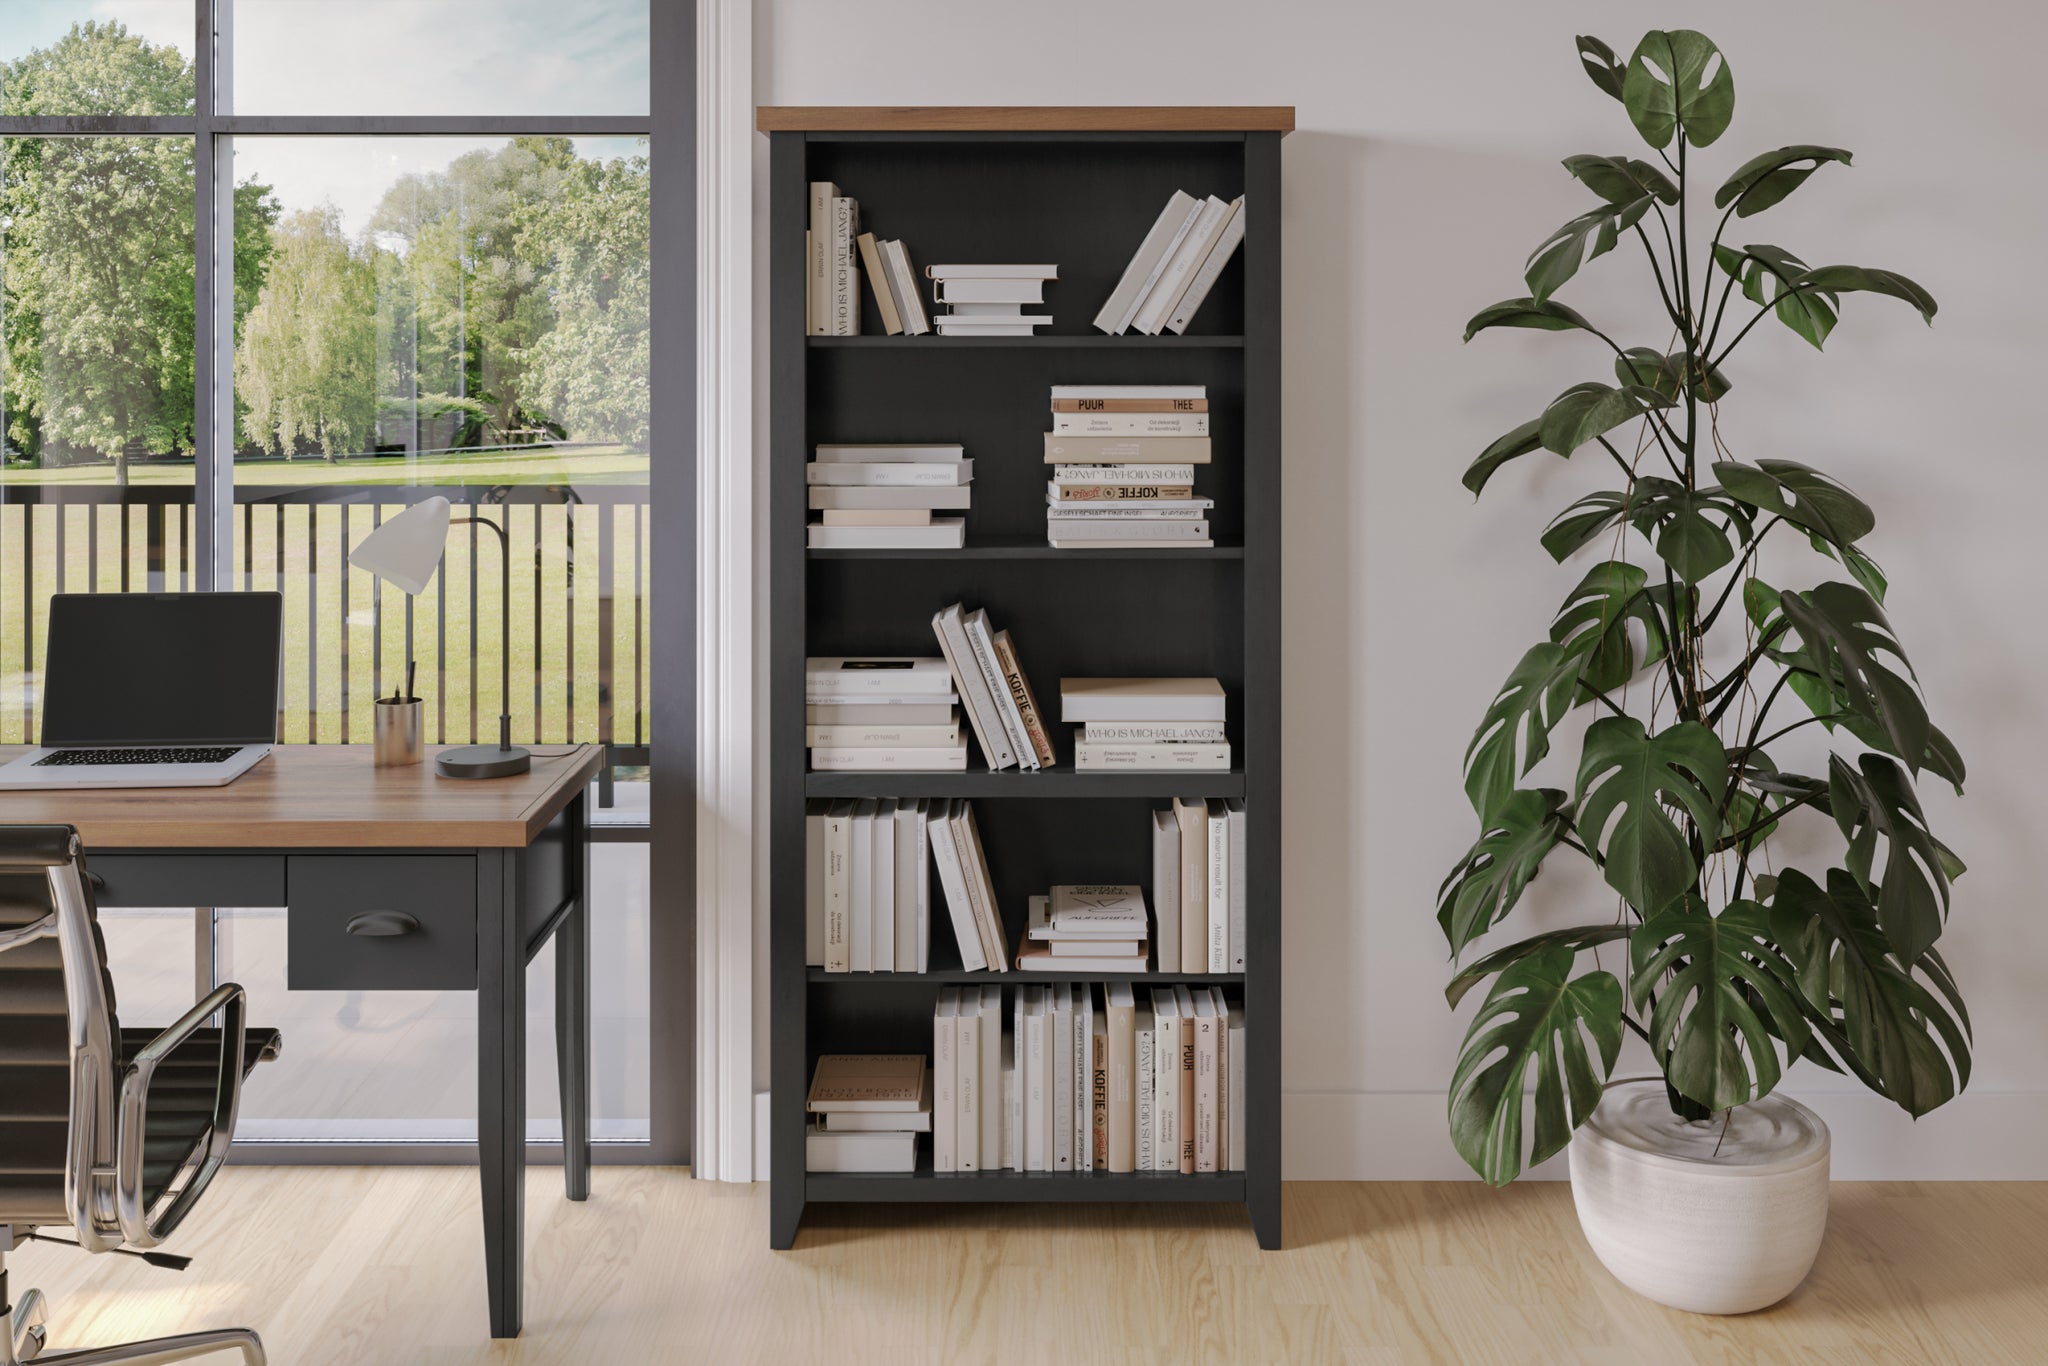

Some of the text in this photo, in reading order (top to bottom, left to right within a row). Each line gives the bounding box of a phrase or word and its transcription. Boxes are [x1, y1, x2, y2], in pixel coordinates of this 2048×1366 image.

[838, 206, 848, 336] WHO IS MICHAEL JANG?
[1078, 400, 1193, 410] PUUR THEE
[1065, 470, 1193, 479] WHO IS MICHAEL JANG?
[1118, 487, 1158, 498] KOFFIE
[1008, 673, 1032, 713] KOFFIE
[1087, 729, 1215, 738] WHO IS MICHAEL JANG?
[1214, 822, 1223, 900] No search result for
[1214, 923, 1223, 969] Anita Klinz
[1164, 1022, 1170, 1031] 1
[1202, 1024, 1210, 1033] 2
[1095, 1069, 1106, 1110] KOFFIE
[1141, 1041, 1151, 1170] WHO IS MICHAEL JANG?
[1184, 1045, 1194, 1160] PUUR THEE
